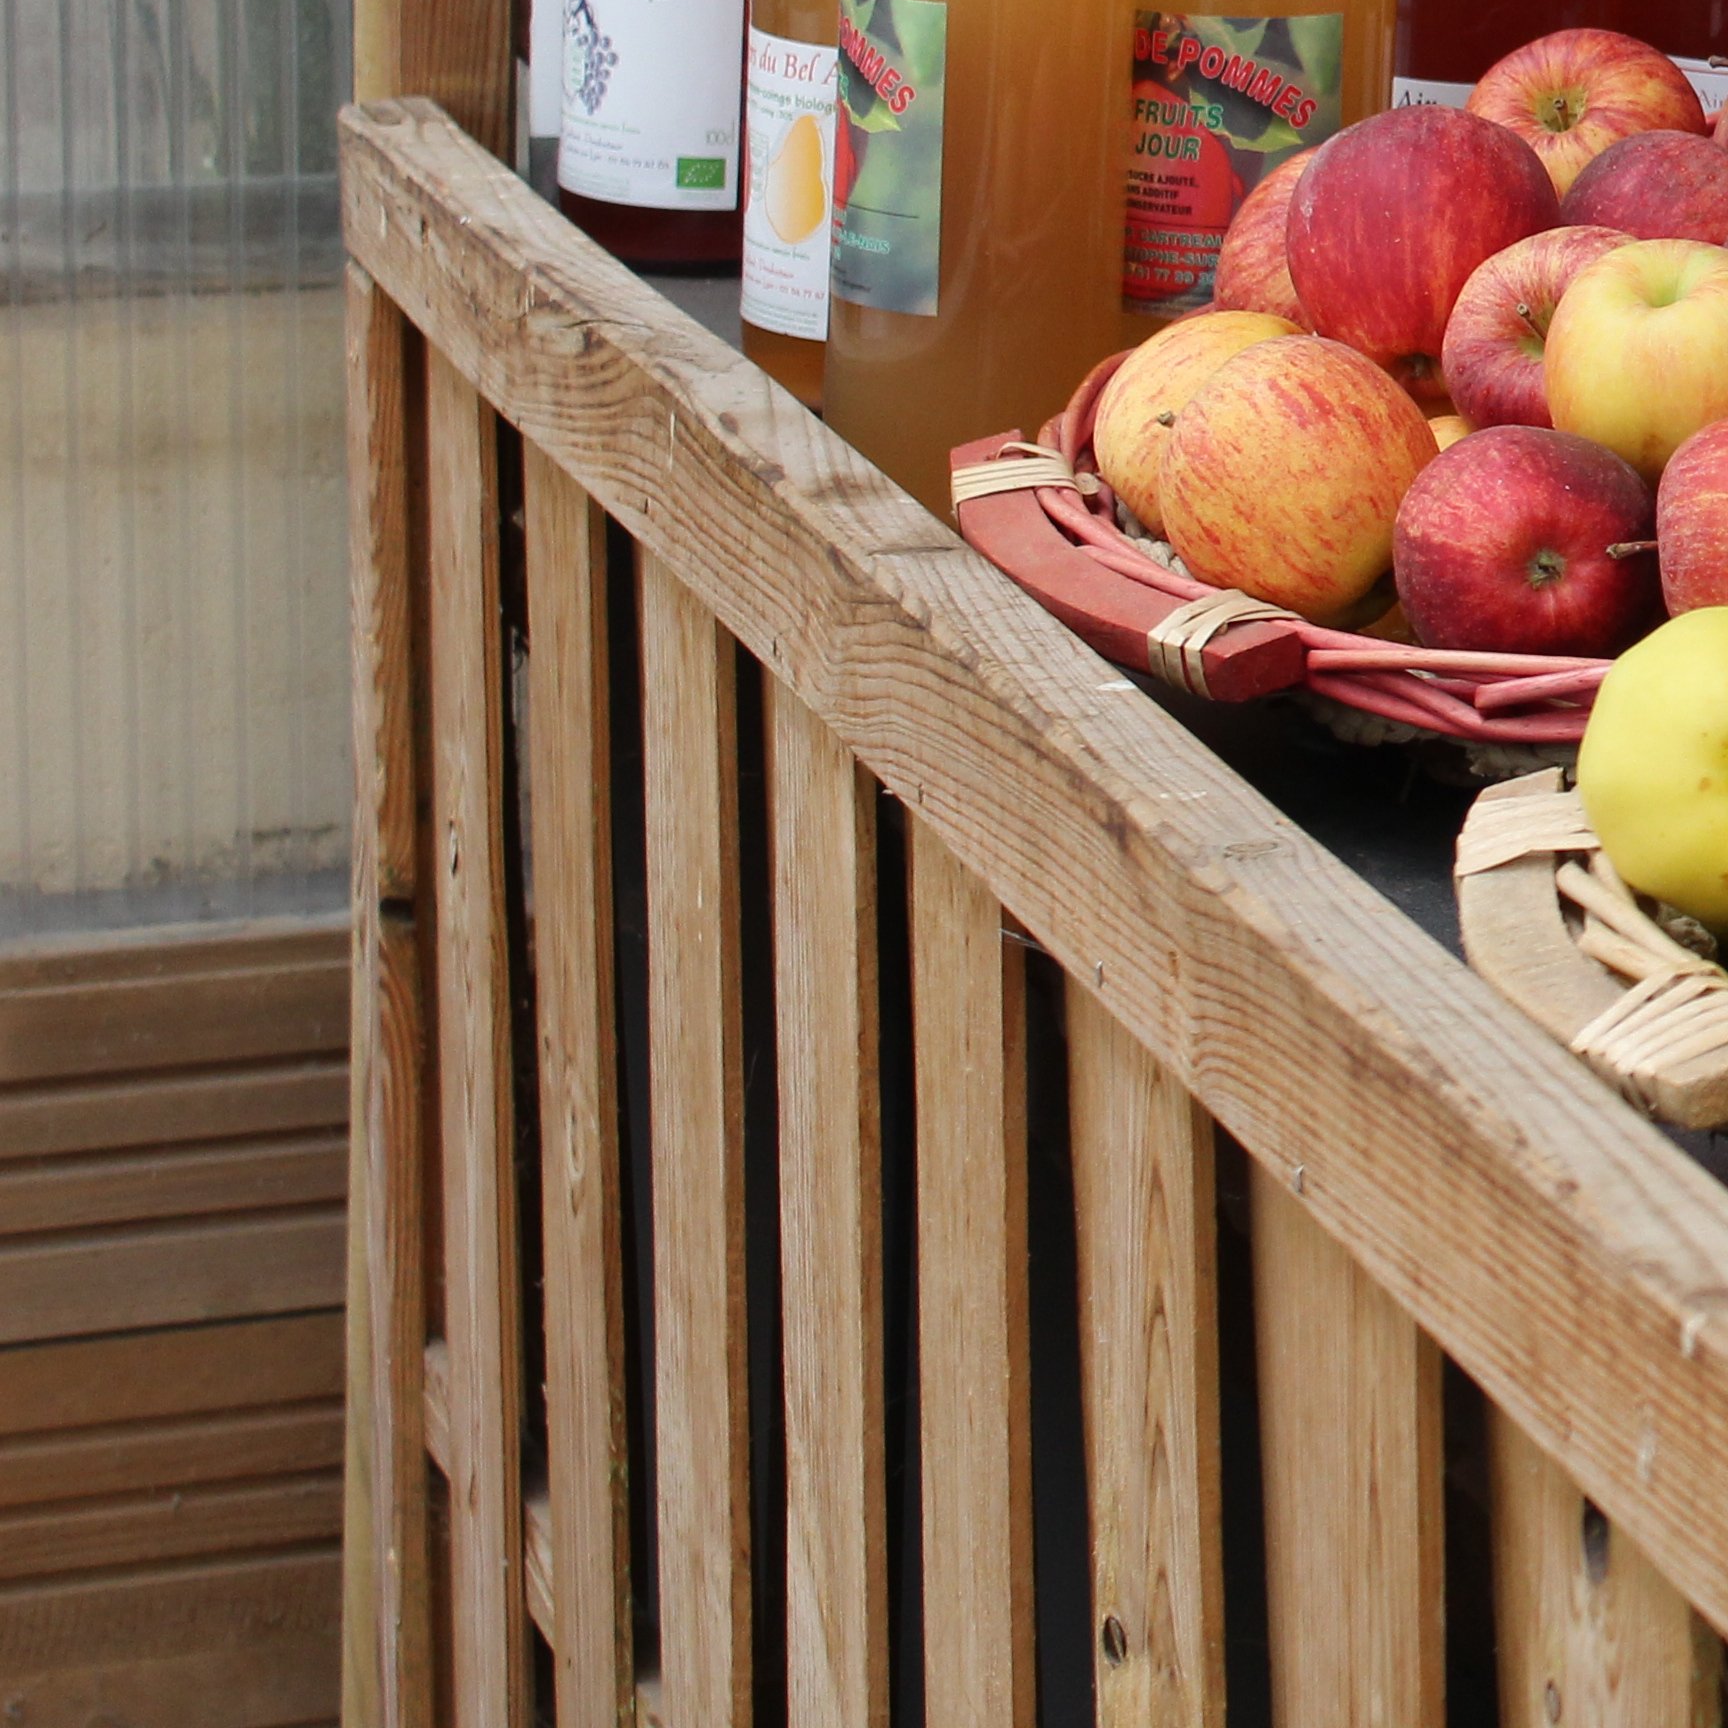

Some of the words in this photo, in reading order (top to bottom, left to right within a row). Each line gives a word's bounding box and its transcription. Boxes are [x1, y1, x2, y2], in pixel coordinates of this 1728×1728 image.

[758, 43, 778, 73] du
[783, 52, 821, 82] Bel
[841, 15, 915, 115] OMMES
[1134, 28, 1168, 64] DE
[1177, 37, 1318, 129] POMMES
[1135, 98, 1224, 130] FRUITS
[1135, 132, 1202, 161] JOUR
